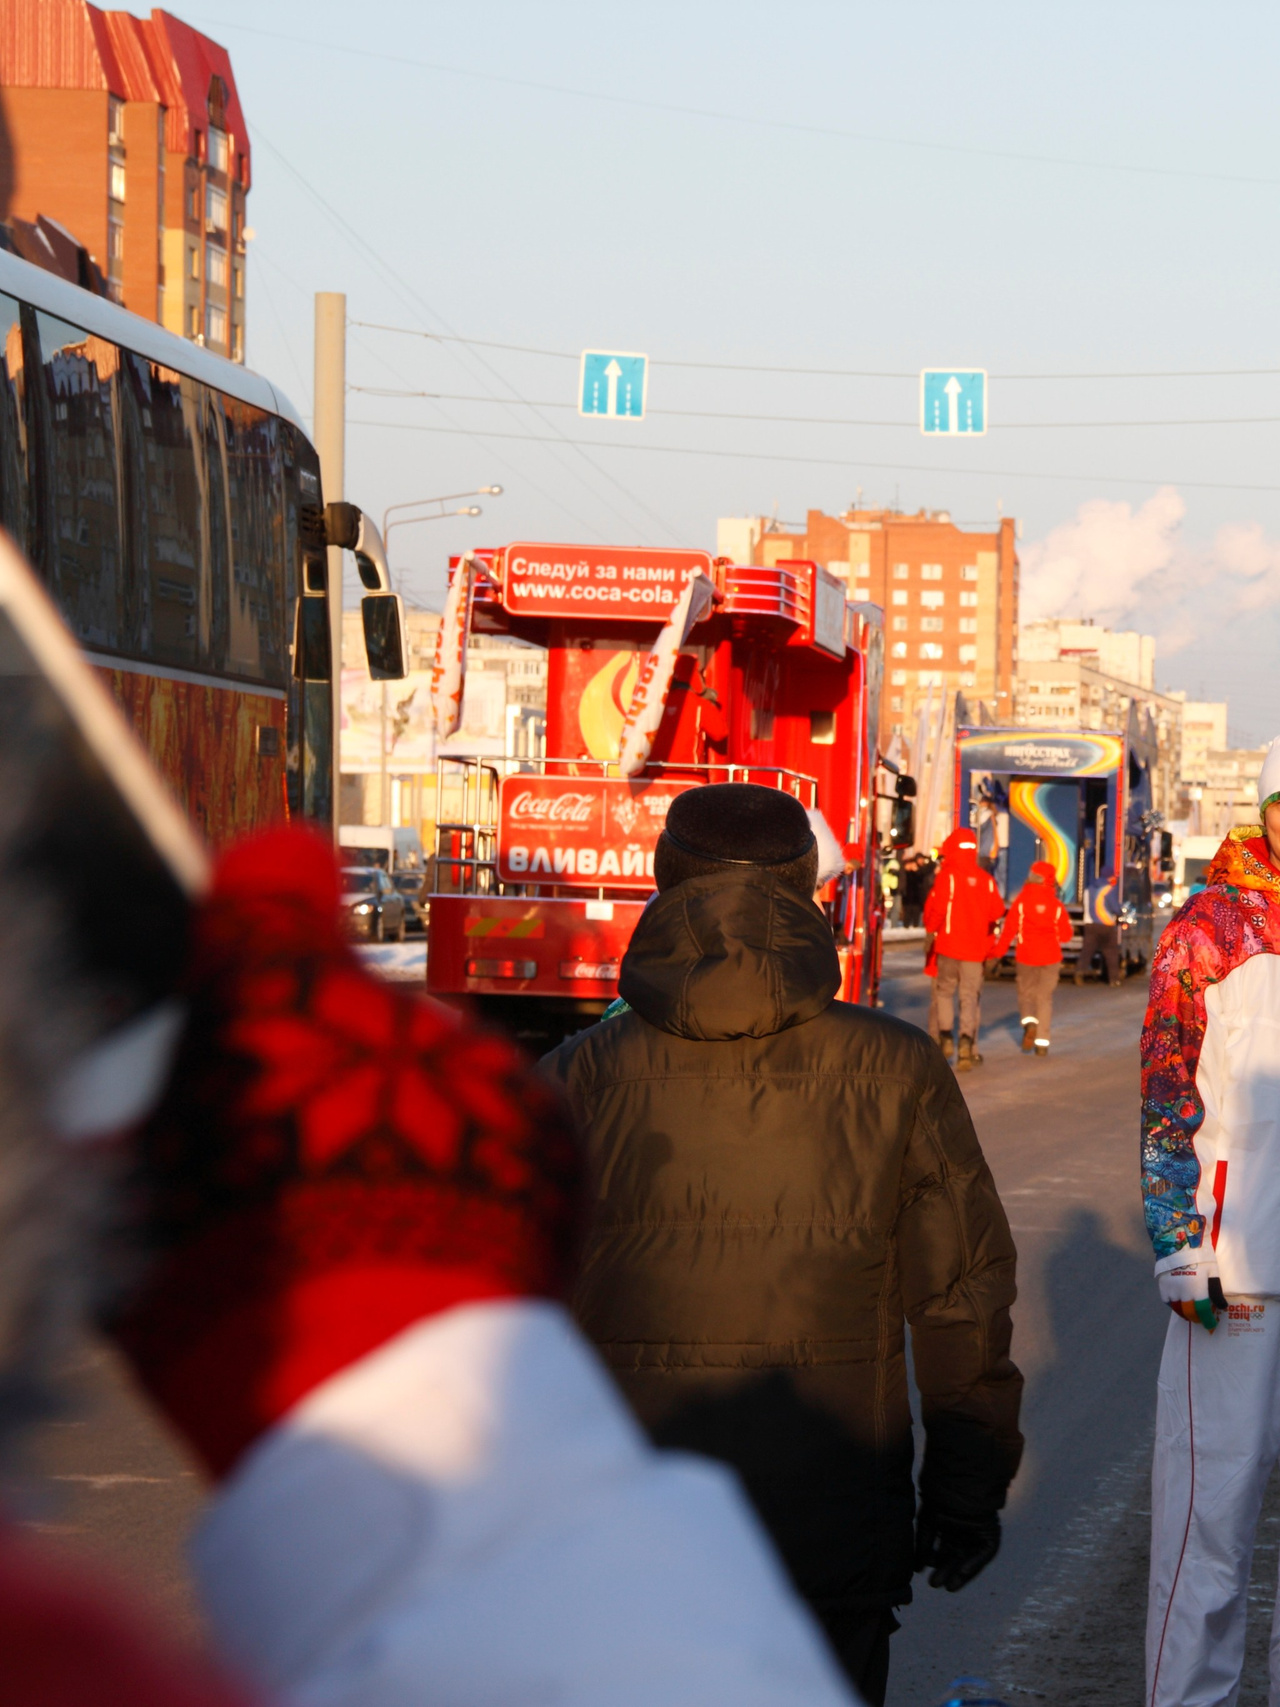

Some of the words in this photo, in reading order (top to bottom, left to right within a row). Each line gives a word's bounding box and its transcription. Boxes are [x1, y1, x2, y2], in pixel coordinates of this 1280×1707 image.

[511, 557, 589, 582] Следуй
[595, 565, 617, 579] за
[623, 566, 675, 582] нами
[681, 569, 694, 582] н
[644, 794, 672, 806] soch
[1228, 1312, 1250, 1321] 2014
